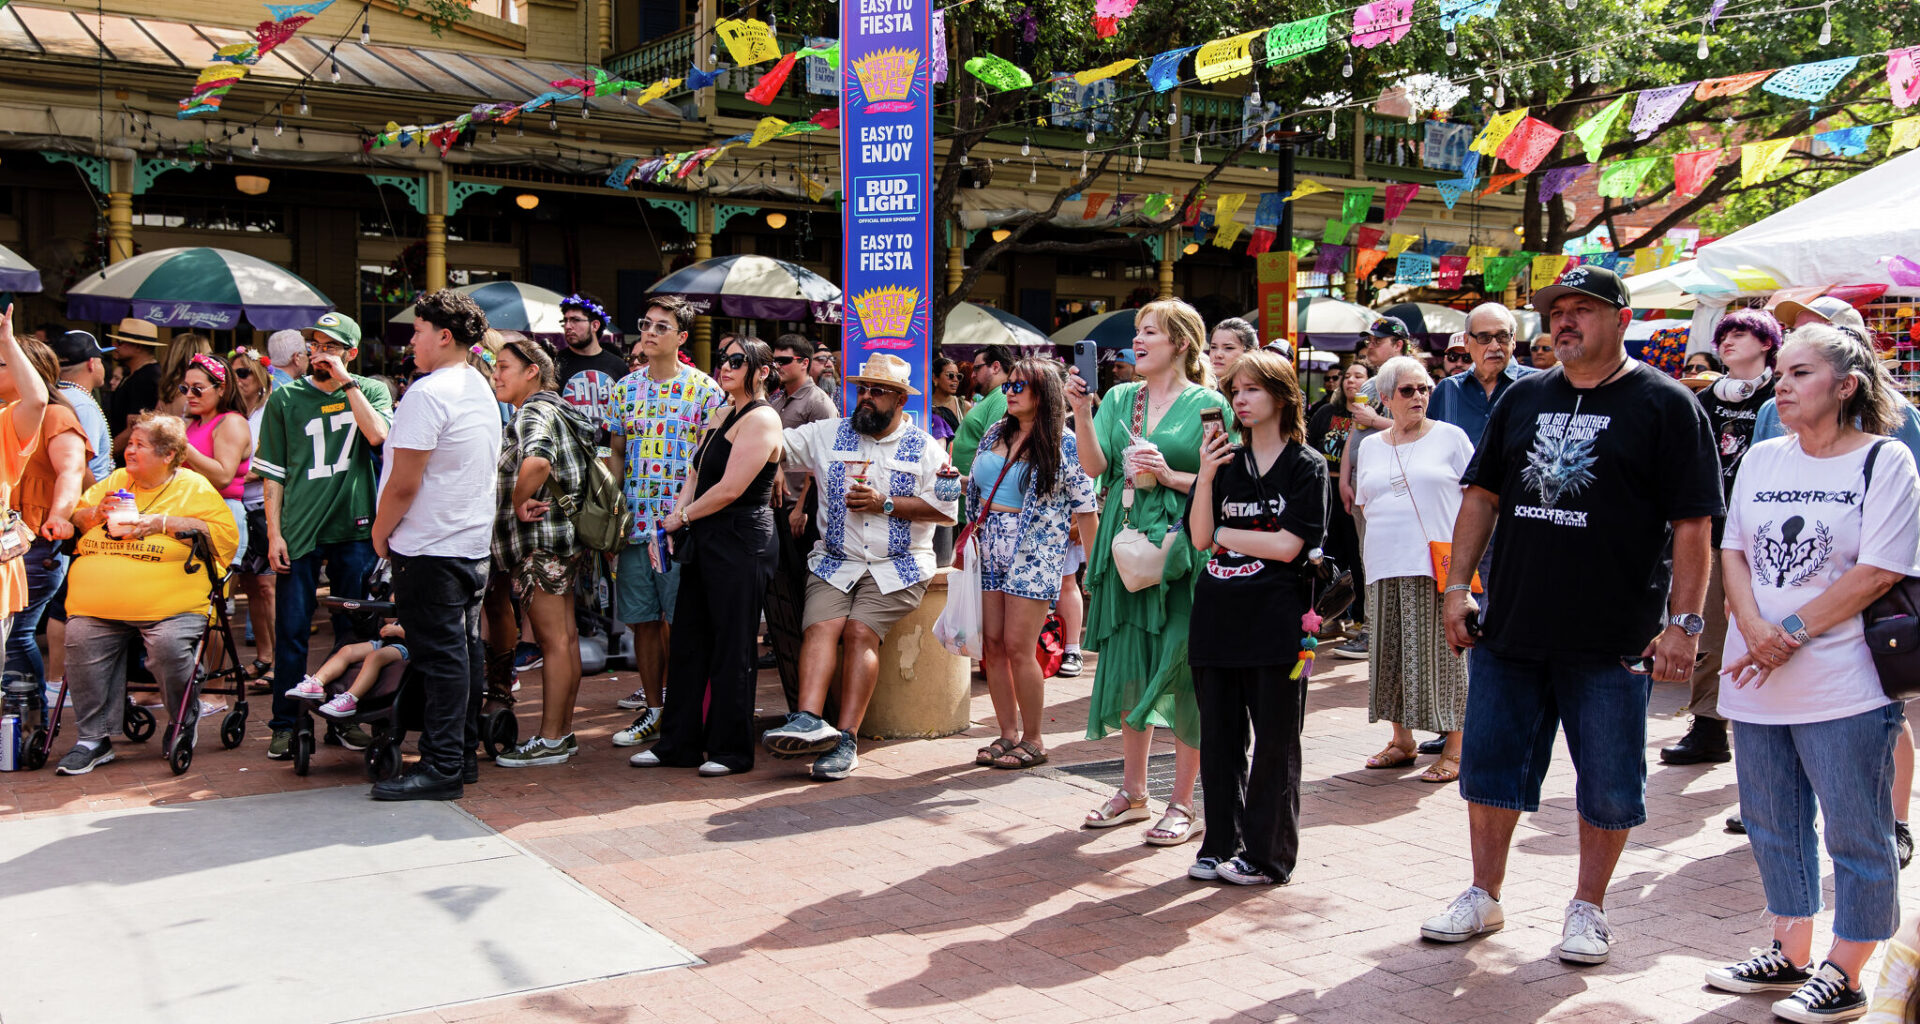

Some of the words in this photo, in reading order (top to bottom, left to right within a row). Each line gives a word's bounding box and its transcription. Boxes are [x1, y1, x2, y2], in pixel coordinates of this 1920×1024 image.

[860, 0, 893, 14] EASY
[897, 0, 913, 11] TO
[860, 13, 913, 35] FIESTA
[864, 56, 905, 75] FIESTA
[864, 78, 907, 98] REYES
[861, 126, 894, 142] EASY
[896, 124, 913, 140] TO
[862, 142, 913, 163] ENJOY
[866, 179, 908, 196] BUD
[858, 194, 917, 212] LIGHT
[860, 235, 894, 250] EASY
[896, 233, 913, 249] TO
[860, 251, 913, 271] FIESTA
[864, 293, 905, 312] FIESTA
[144, 305, 164, 320] La
[163, 303, 230, 328] Margarita
[864, 315, 907, 334] REYES
[1536, 413, 1554, 425] YOU
[1552, 413, 1571, 427] GOT
[1569, 414, 1611, 429] ANOTHER
[1538, 424, 1566, 439] THING
[305, 411, 358, 480] 17
[1753, 490, 1801, 502] SCHOOL
[1811, 490, 1858, 505] ROCK
[1514, 505, 1547, 519] SCHOOL
[1555, 509, 1588, 522] ROCK
[100, 541, 125, 551] OYSTER
[127, 542, 145, 552] BAKE
[147, 544, 165, 554] 2022
